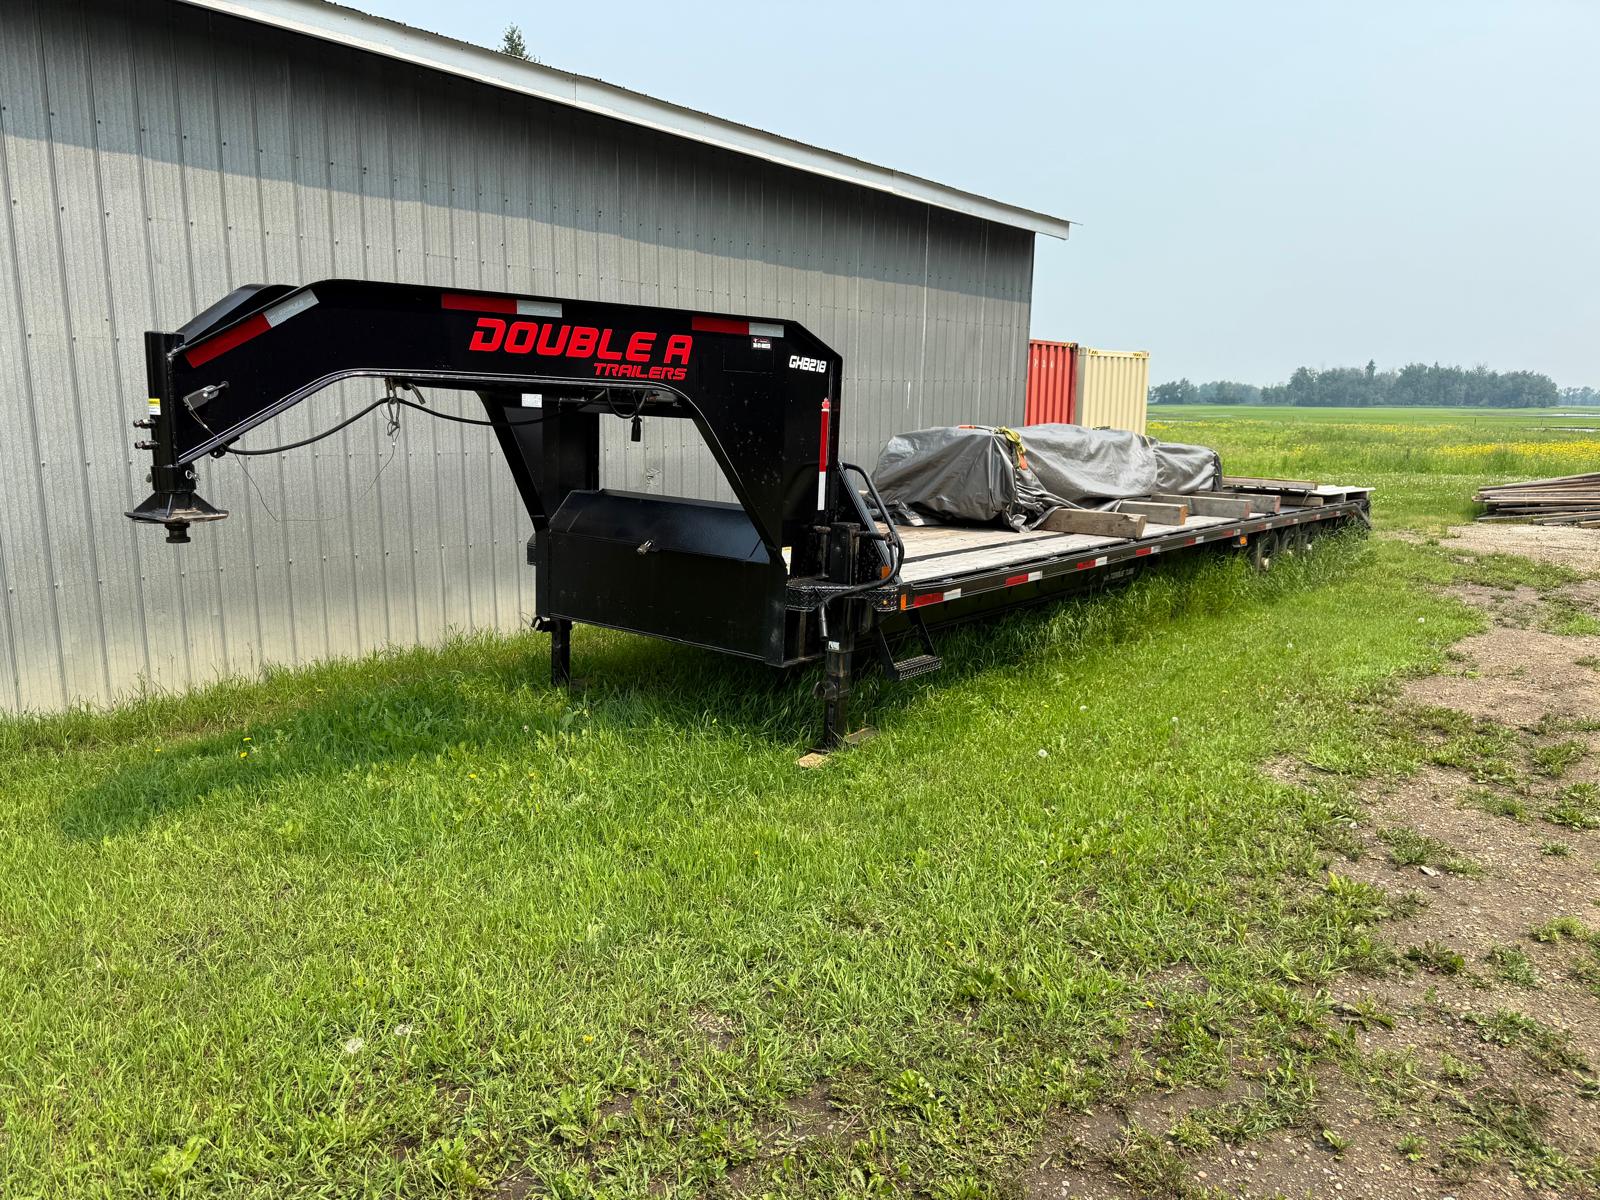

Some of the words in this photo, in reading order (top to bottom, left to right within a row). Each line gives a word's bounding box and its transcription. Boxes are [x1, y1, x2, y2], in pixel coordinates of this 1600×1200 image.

[469, 318, 656, 362] DOUBLE
[664, 335, 693, 364] A
[594, 363, 687, 380] TRAILERS
